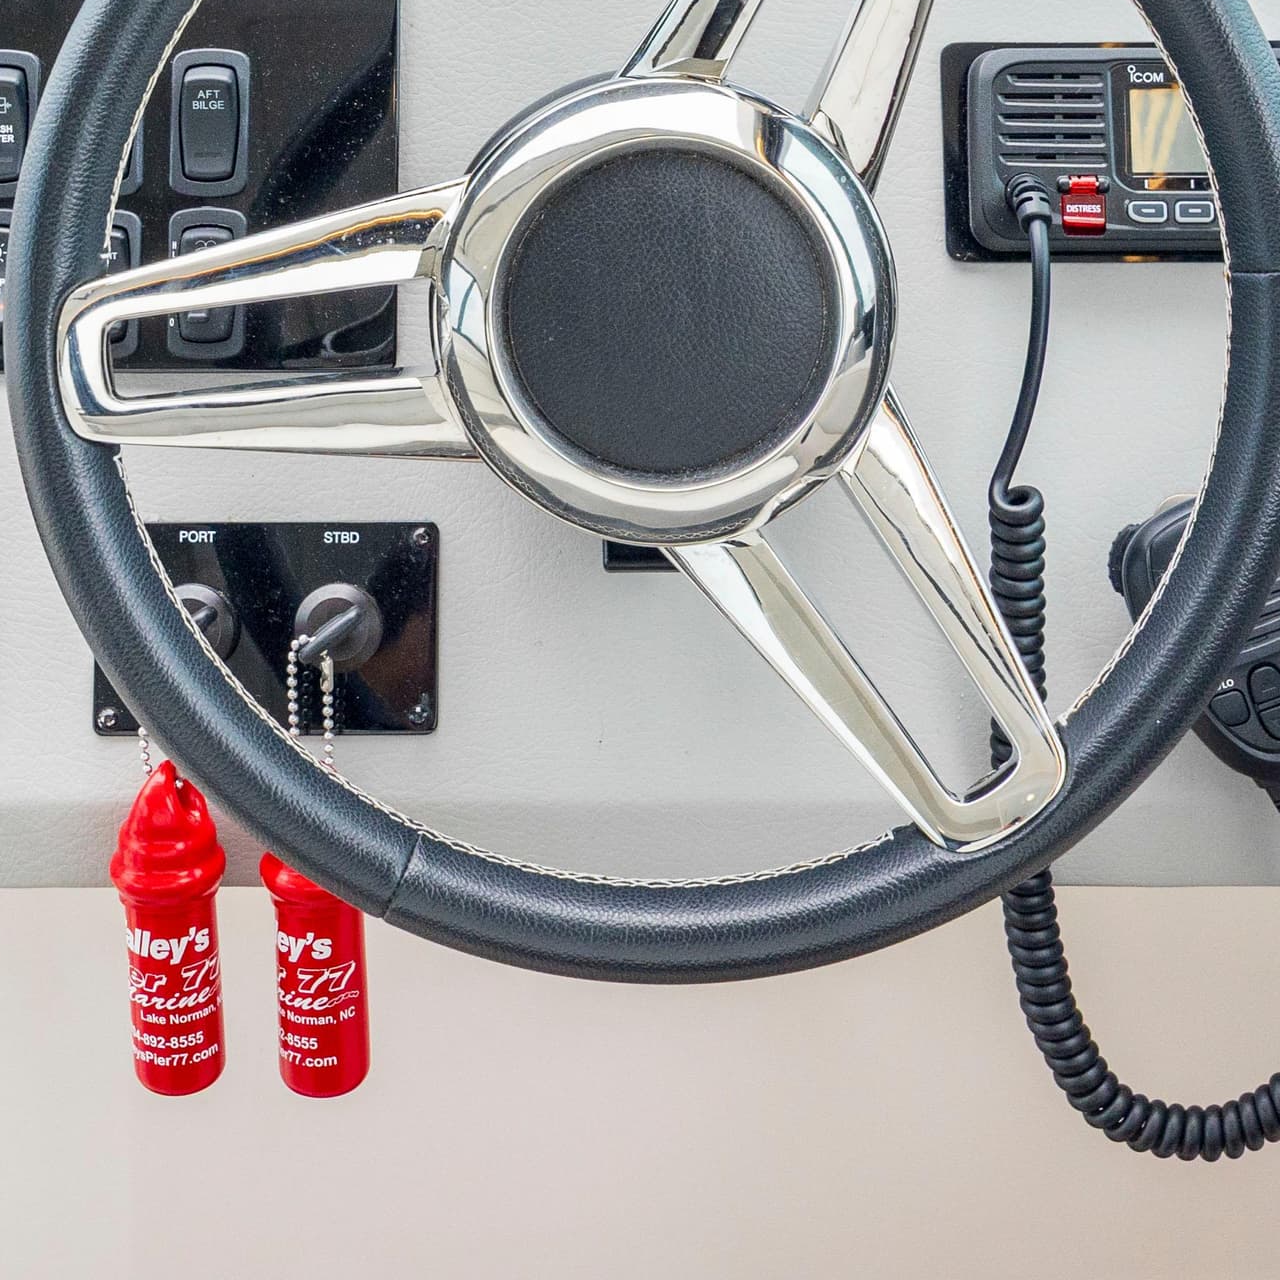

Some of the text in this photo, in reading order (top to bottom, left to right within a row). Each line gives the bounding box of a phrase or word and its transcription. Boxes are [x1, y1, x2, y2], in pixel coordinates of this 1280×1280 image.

[197, 89, 221, 99] AFT
[192, 100, 225, 110] BILGE
[1066, 204, 1102, 213] DISTRESS
[179, 530, 216, 544] PORT
[323, 531, 360, 544] STBD
[296, 960, 357, 994] 77
[140, 1004, 217, 1024] Lake Norman,
[286, 1009, 337, 1025] Norman,
[340, 1006, 356, 1021] NC
